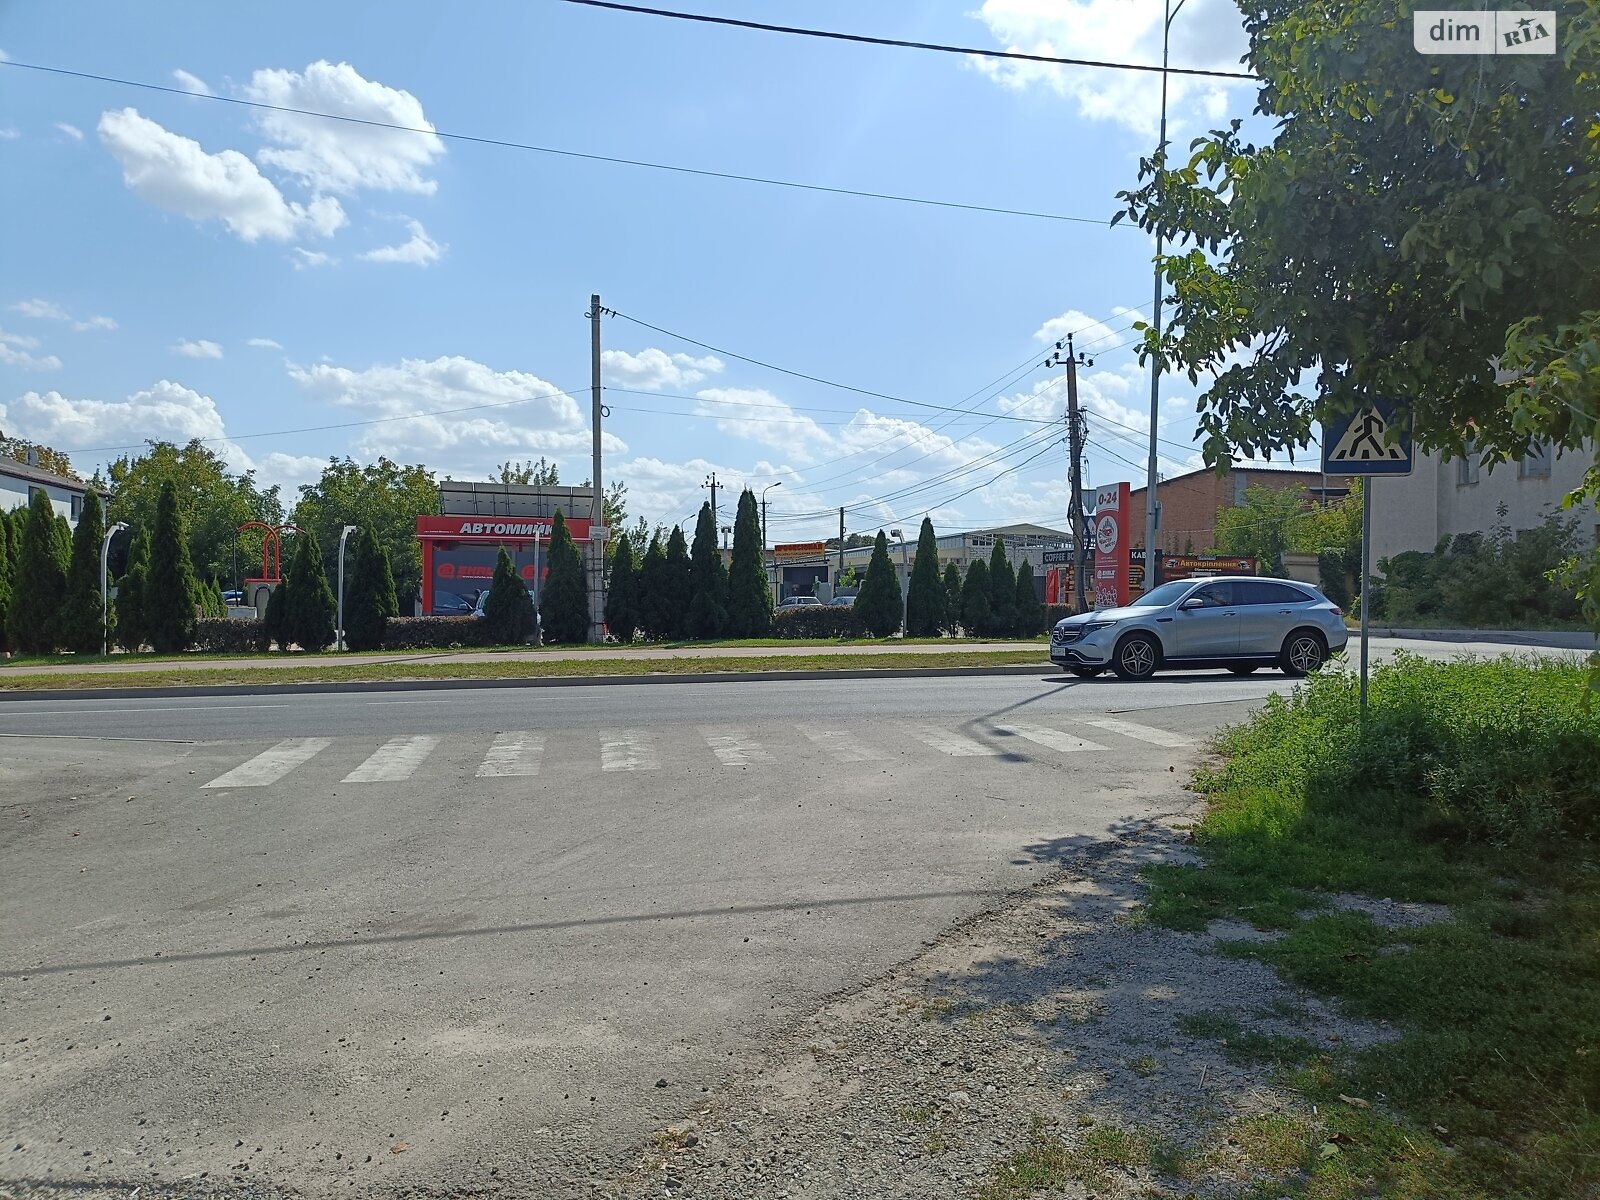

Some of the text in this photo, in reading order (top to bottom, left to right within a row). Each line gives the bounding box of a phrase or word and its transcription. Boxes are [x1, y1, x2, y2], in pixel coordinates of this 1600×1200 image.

[1098, 491, 1118, 506] 0-24
[459, 521, 553, 536] АВТОМИЙК
[1044, 553, 1066, 562] COFFEE
